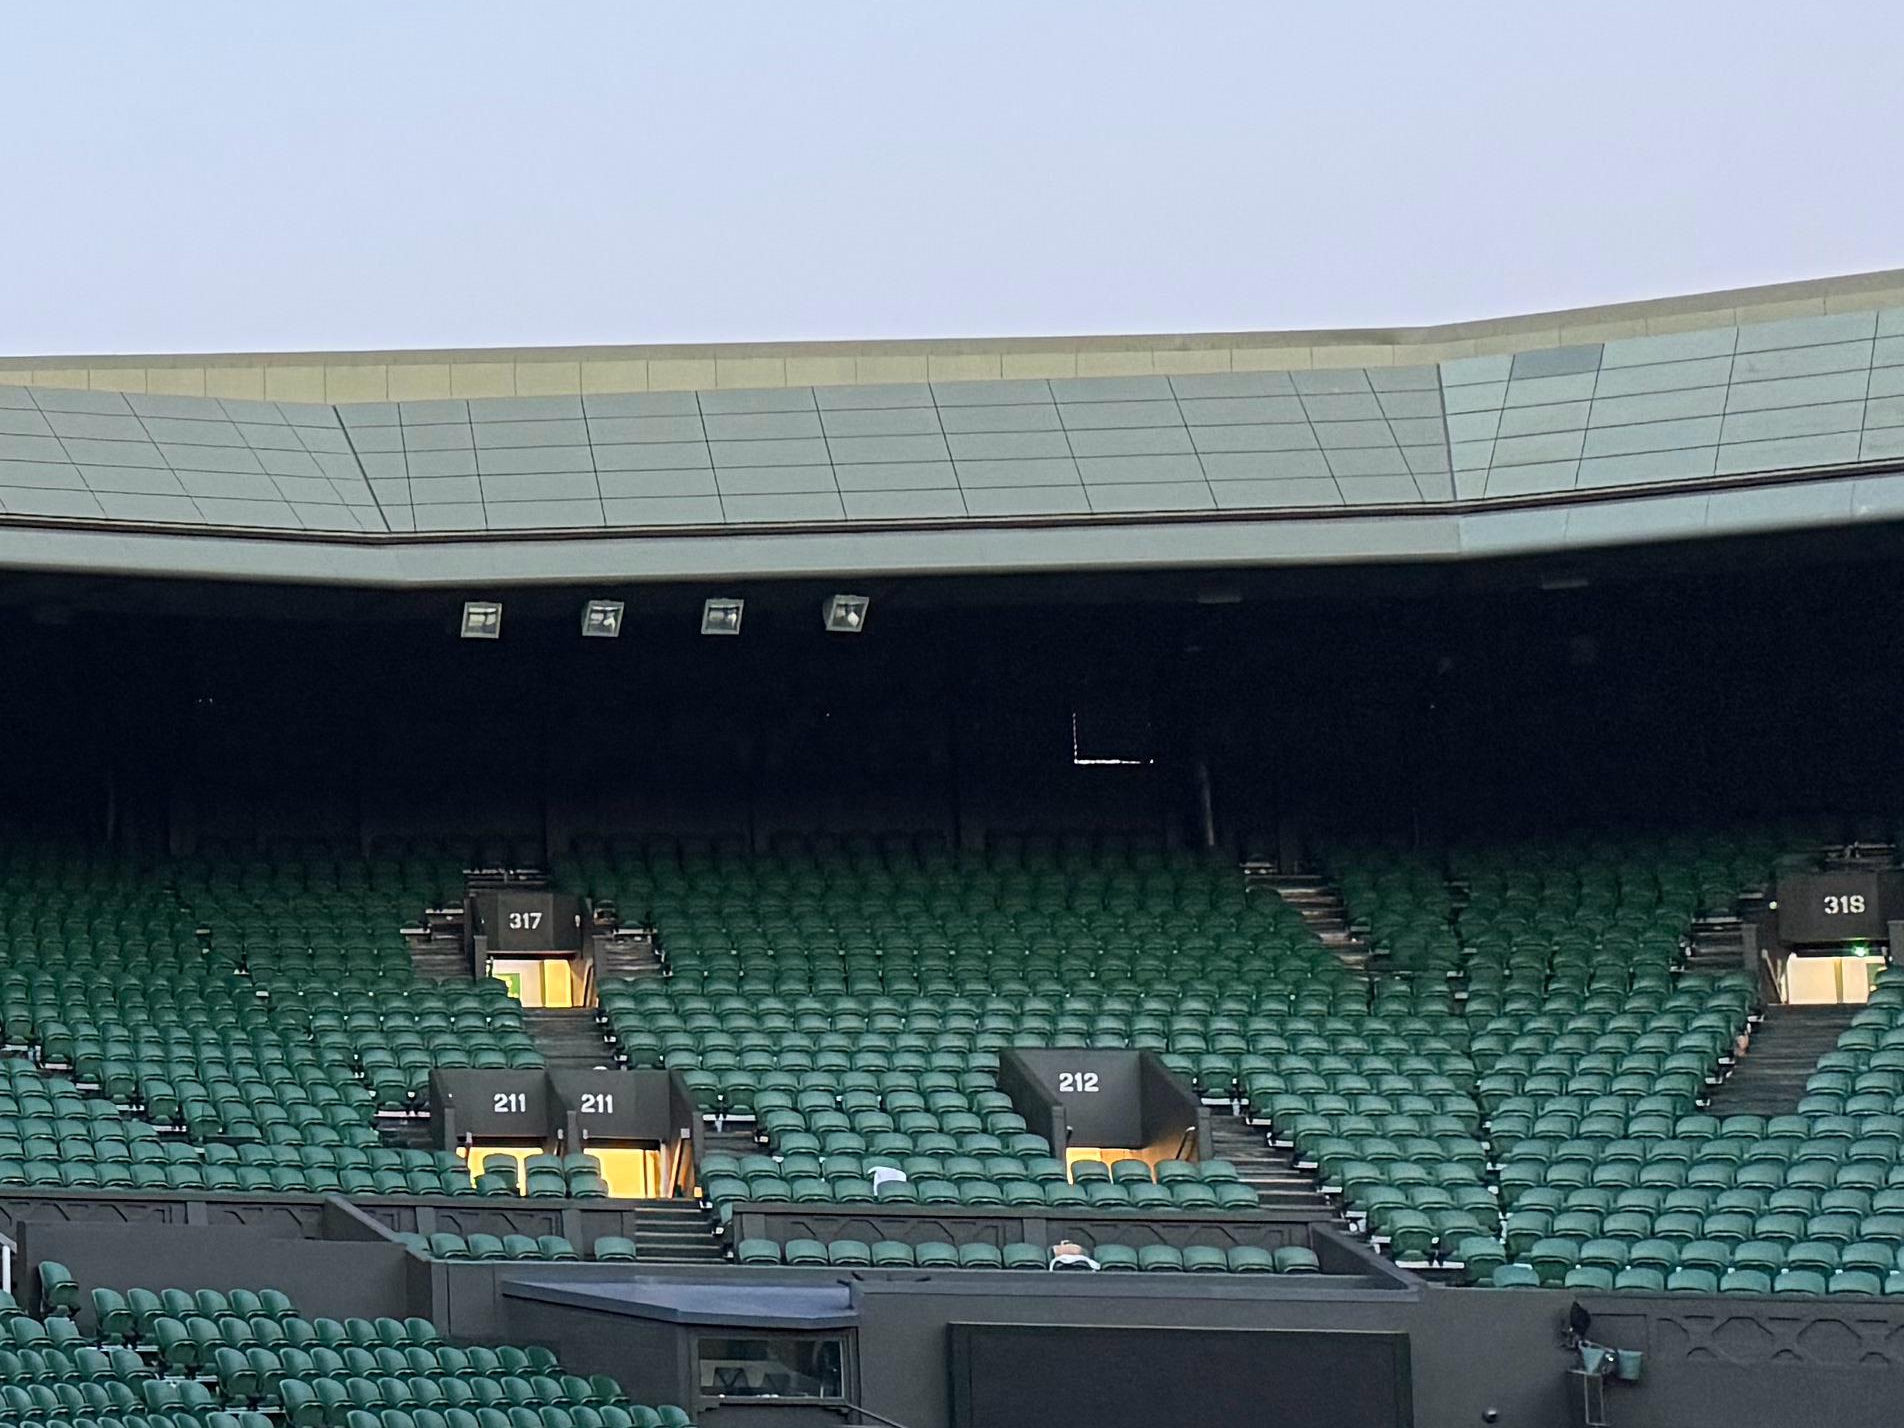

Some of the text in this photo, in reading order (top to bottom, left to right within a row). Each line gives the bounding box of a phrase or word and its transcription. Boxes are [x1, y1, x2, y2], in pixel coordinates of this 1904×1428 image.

[1823, 894, 1866, 915] 318
[509, 912, 543, 930] 317
[1059, 1071, 1100, 1093] 212
[493, 1093, 526, 1113] 211
[580, 1093, 614, 1114] 211
